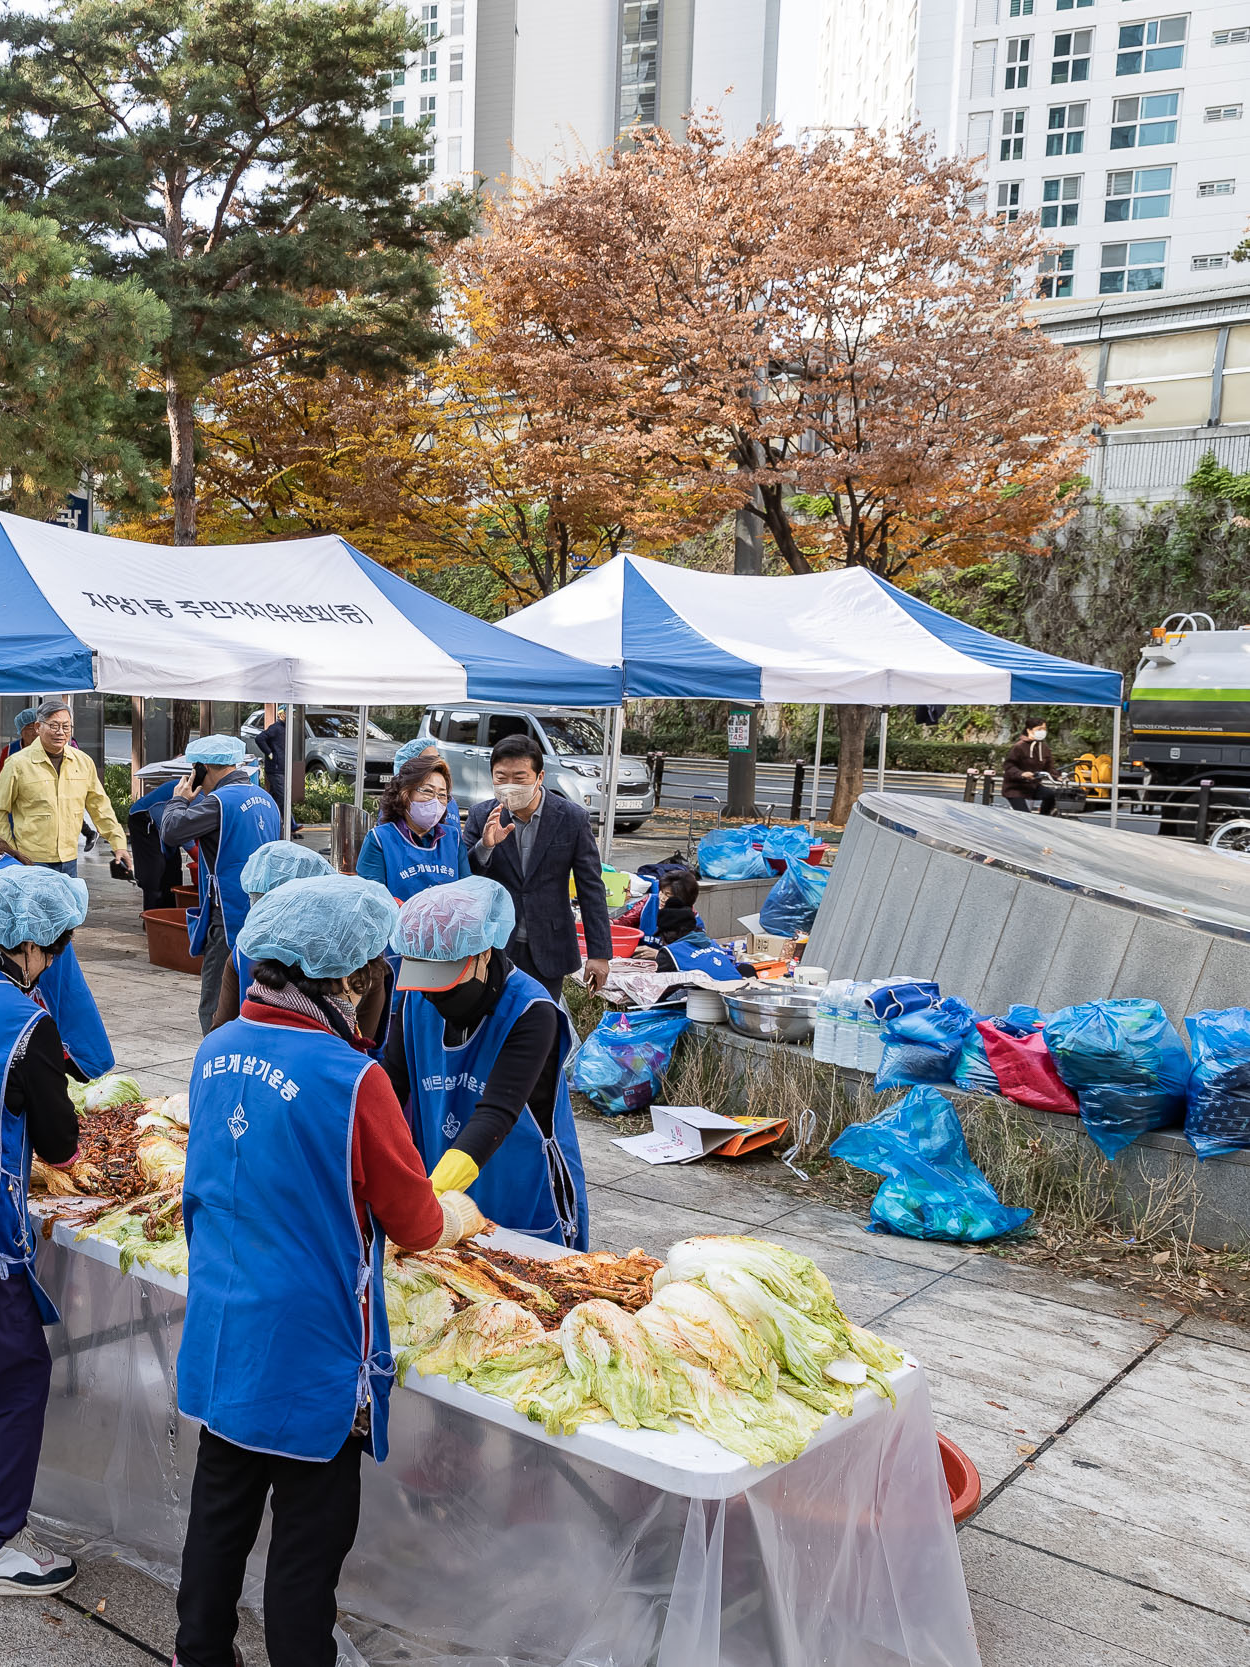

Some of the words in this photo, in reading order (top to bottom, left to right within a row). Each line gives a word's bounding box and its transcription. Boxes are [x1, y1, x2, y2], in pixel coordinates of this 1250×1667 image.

[82, 591, 174, 619] 자양1동
[399, 864, 455, 880] 바르게살기운동
[202, 1053, 301, 1102] 바르게살기운동
